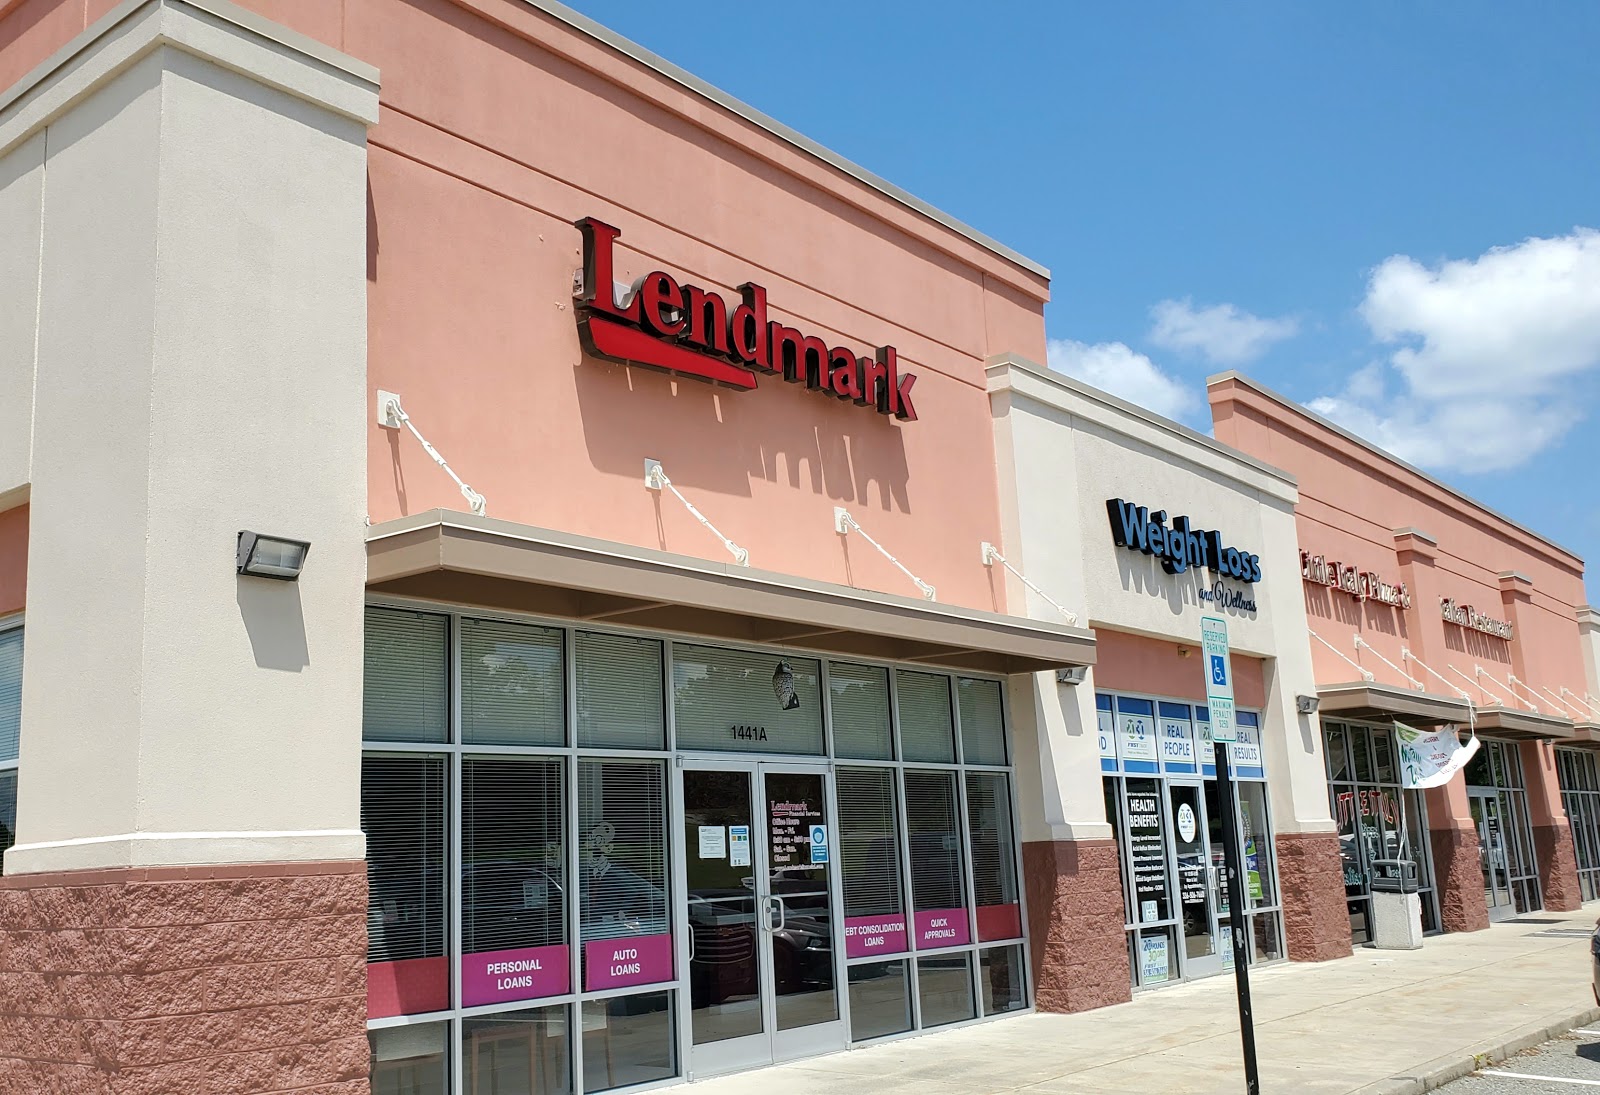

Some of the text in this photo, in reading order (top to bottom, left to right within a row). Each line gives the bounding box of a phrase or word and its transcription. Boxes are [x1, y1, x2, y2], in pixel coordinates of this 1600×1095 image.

[573, 216, 918, 422] Lendmark
[1106, 498, 1262, 583] Weight Loss
[1299, 548, 1337, 588] Little
[1198, 580, 1257, 613] and Wellness
[1203, 629, 1226, 644] RESERVED
[1206, 642, 1226, 656] PARKING
[1212, 699, 1232, 709] MAXIMUM
[1213, 709, 1232, 719] PENALTY
[731, 725, 768, 742] 1441A
[1167, 725, 1185, 739] REAL
[1237, 731, 1252, 745] REAL
[1164, 741, 1190, 757] PEOPLE
[1234, 746, 1258, 761] RESULTS
[770, 800, 807, 811] Lendmark
[1130, 799, 1155, 812] HEALTH
[845, 922, 905, 936] EBT CONSOLIDATION
[930, 918, 948, 928] QUICK
[924, 928, 956, 940] APPROVALS
[864, 936, 885, 947] LOANS
[612, 948, 638, 961] AUTO
[486, 958, 543, 975] PERSONAL
[610, 962, 641, 977] LOANS
[497, 975, 533, 990] LOANS
